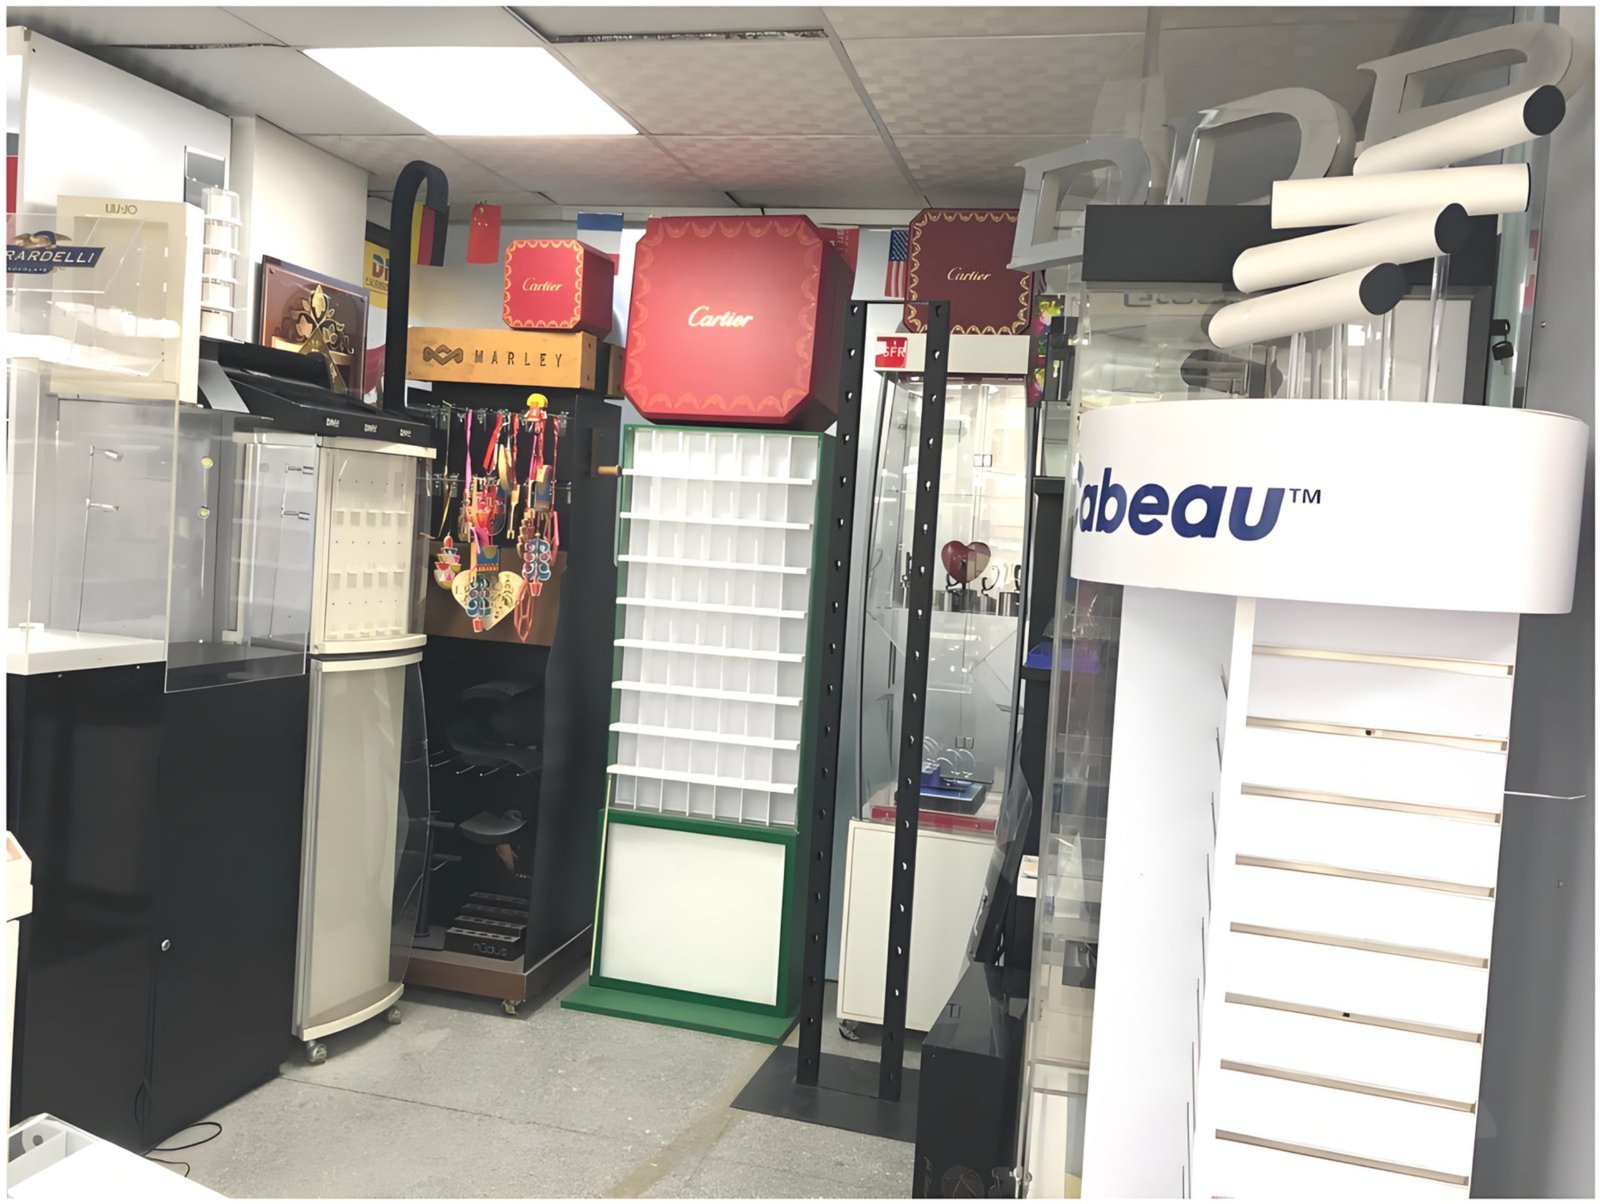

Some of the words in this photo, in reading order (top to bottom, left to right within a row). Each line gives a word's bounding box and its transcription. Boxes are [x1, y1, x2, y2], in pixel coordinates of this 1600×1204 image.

[947, 266, 992, 281] Cartier
[522, 277, 563, 291] Cartier
[688, 304, 754, 328] Cartier
[474, 349, 562, 367] MARLEY
[883, 346, 905, 358] SFR
